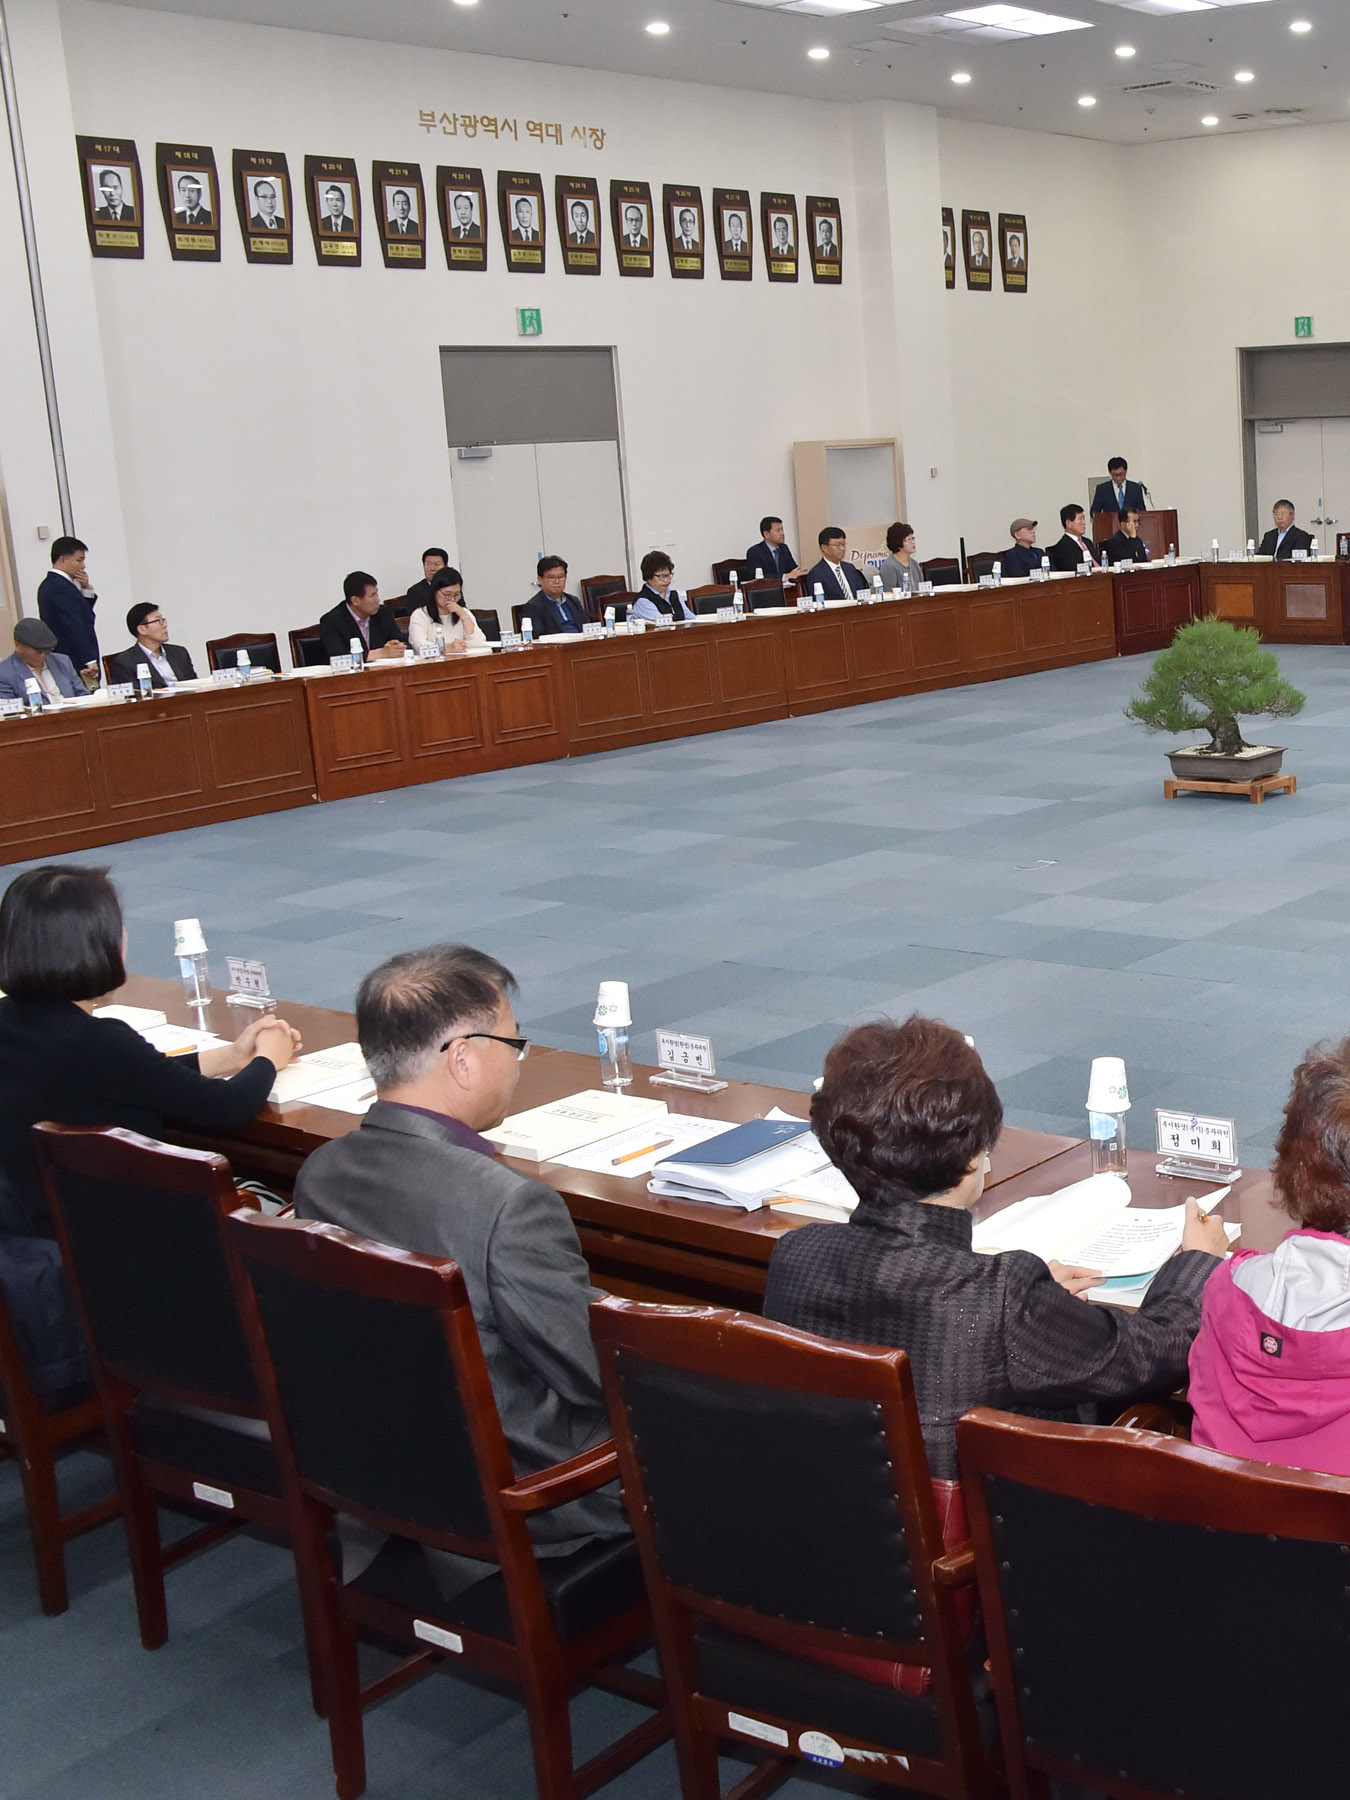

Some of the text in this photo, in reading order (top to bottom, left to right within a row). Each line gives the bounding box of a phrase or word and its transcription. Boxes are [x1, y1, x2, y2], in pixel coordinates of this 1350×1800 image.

[418, 109, 606, 151] 부산광역시 역대 시장
